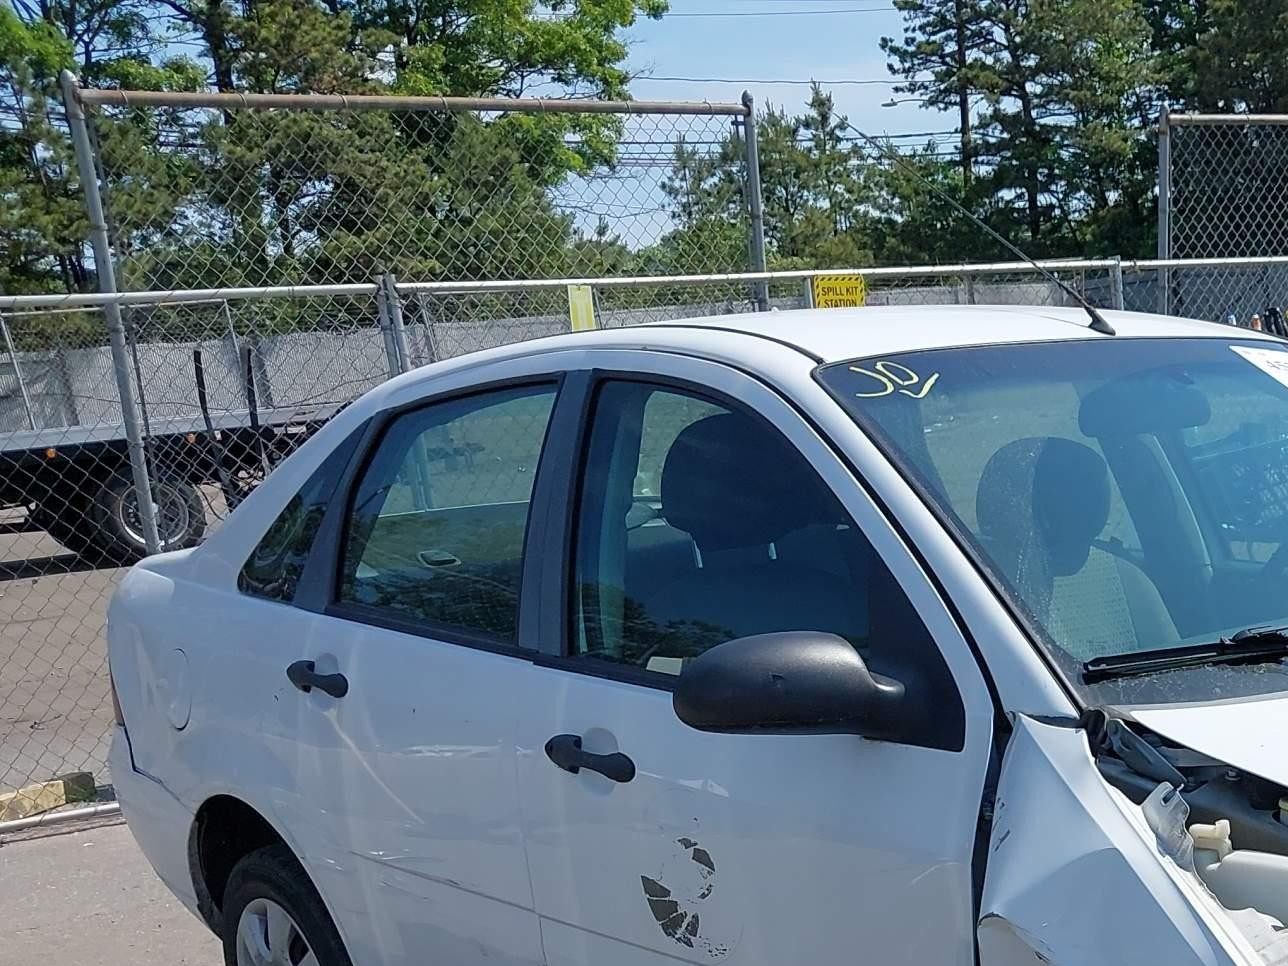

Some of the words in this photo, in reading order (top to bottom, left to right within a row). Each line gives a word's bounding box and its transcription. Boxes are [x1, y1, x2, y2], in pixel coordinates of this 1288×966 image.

[821, 286, 844, 297] SPILL
[846, 286, 859, 297] KIT
[824, 298, 857, 308] STATION
